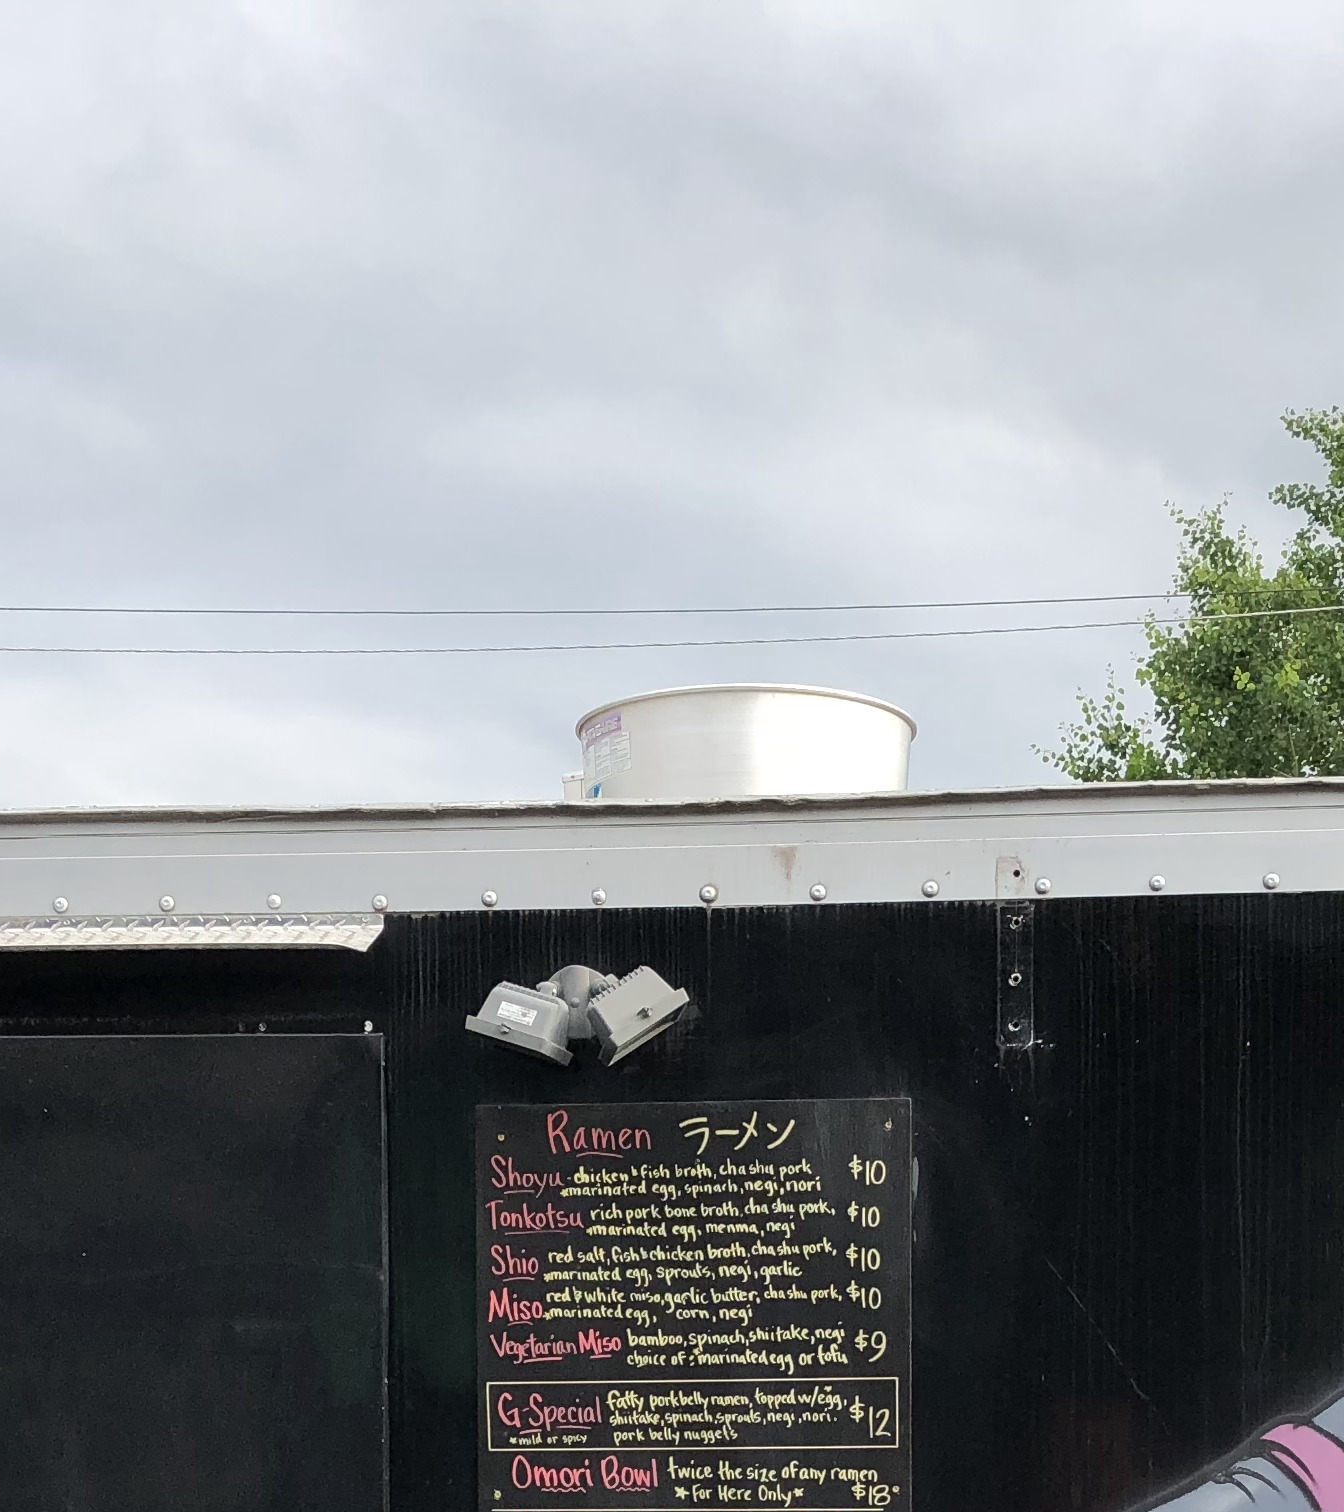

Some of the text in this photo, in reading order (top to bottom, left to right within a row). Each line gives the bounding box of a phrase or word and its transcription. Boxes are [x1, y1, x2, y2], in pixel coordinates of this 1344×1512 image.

[547, 1110, 652, 1154] Ramen
[679, 1111, 796, 1155] ラーメン
[491, 1155, 565, 1198] Shoyu
[640, 1165, 670, 1179] fish
[780, 1158, 812, 1180] pork
[849, 1154, 887, 1185] $10
[568, 1176, 821, 1201] marinated egg, nori
[485, 1198, 881, 1231] Tonkotsu rich pork bone pork, $10
[592, 1222, 667, 1237] marinated
[672, 1225, 702, 1242] egg,
[766, 1215, 796, 1238] negi
[491, 1245, 539, 1275] Shio
[548, 1245, 573, 1263] red
[803, 1237, 837, 1260] pork,
[846, 1243, 881, 1271] $10
[550, 1266, 622, 1281] marinated
[626, 1268, 652, 1287] egg,
[760, 1260, 802, 1284] garlic
[488, 1287, 543, 1322] Miso
[546, 1287, 571, 1303] red
[584, 1287, 626, 1303] white
[811, 1284, 842, 1304] pork,
[846, 1280, 881, 1309] $10
[719, 1304, 752, 1326] negi
[490, 1332, 578, 1364] Vegetarian
[578, 1329, 621, 1355] Miso
[815, 1321, 845, 1343] negi
[854, 1329, 886, 1362] $9
[627, 1349, 666, 1367] choice
[799, 1351, 814, 1365] or
[817, 1343, 848, 1365] tofu
[498, 1392, 602, 1431] G-Special
[606, 1390, 644, 1411] fatty
[755, 1387, 796, 1410] topped
[849, 1395, 891, 1438] $12
[519, 1433, 587, 1445] mild spicy
[614, 1425, 738, 1446] pork belly nuggets
[512, 1454, 659, 1489] Omori Bowl
[667, 1456, 713, 1480] twice
[718, 1460, 742, 1480] the
[746, 1464, 777, 1482] size
[830, 1467, 878, 1483] ramen
[718, 1485, 751, 1502] Here
[758, 1484, 792, 1507] Only
[851, 1481, 891, 1505] $18
